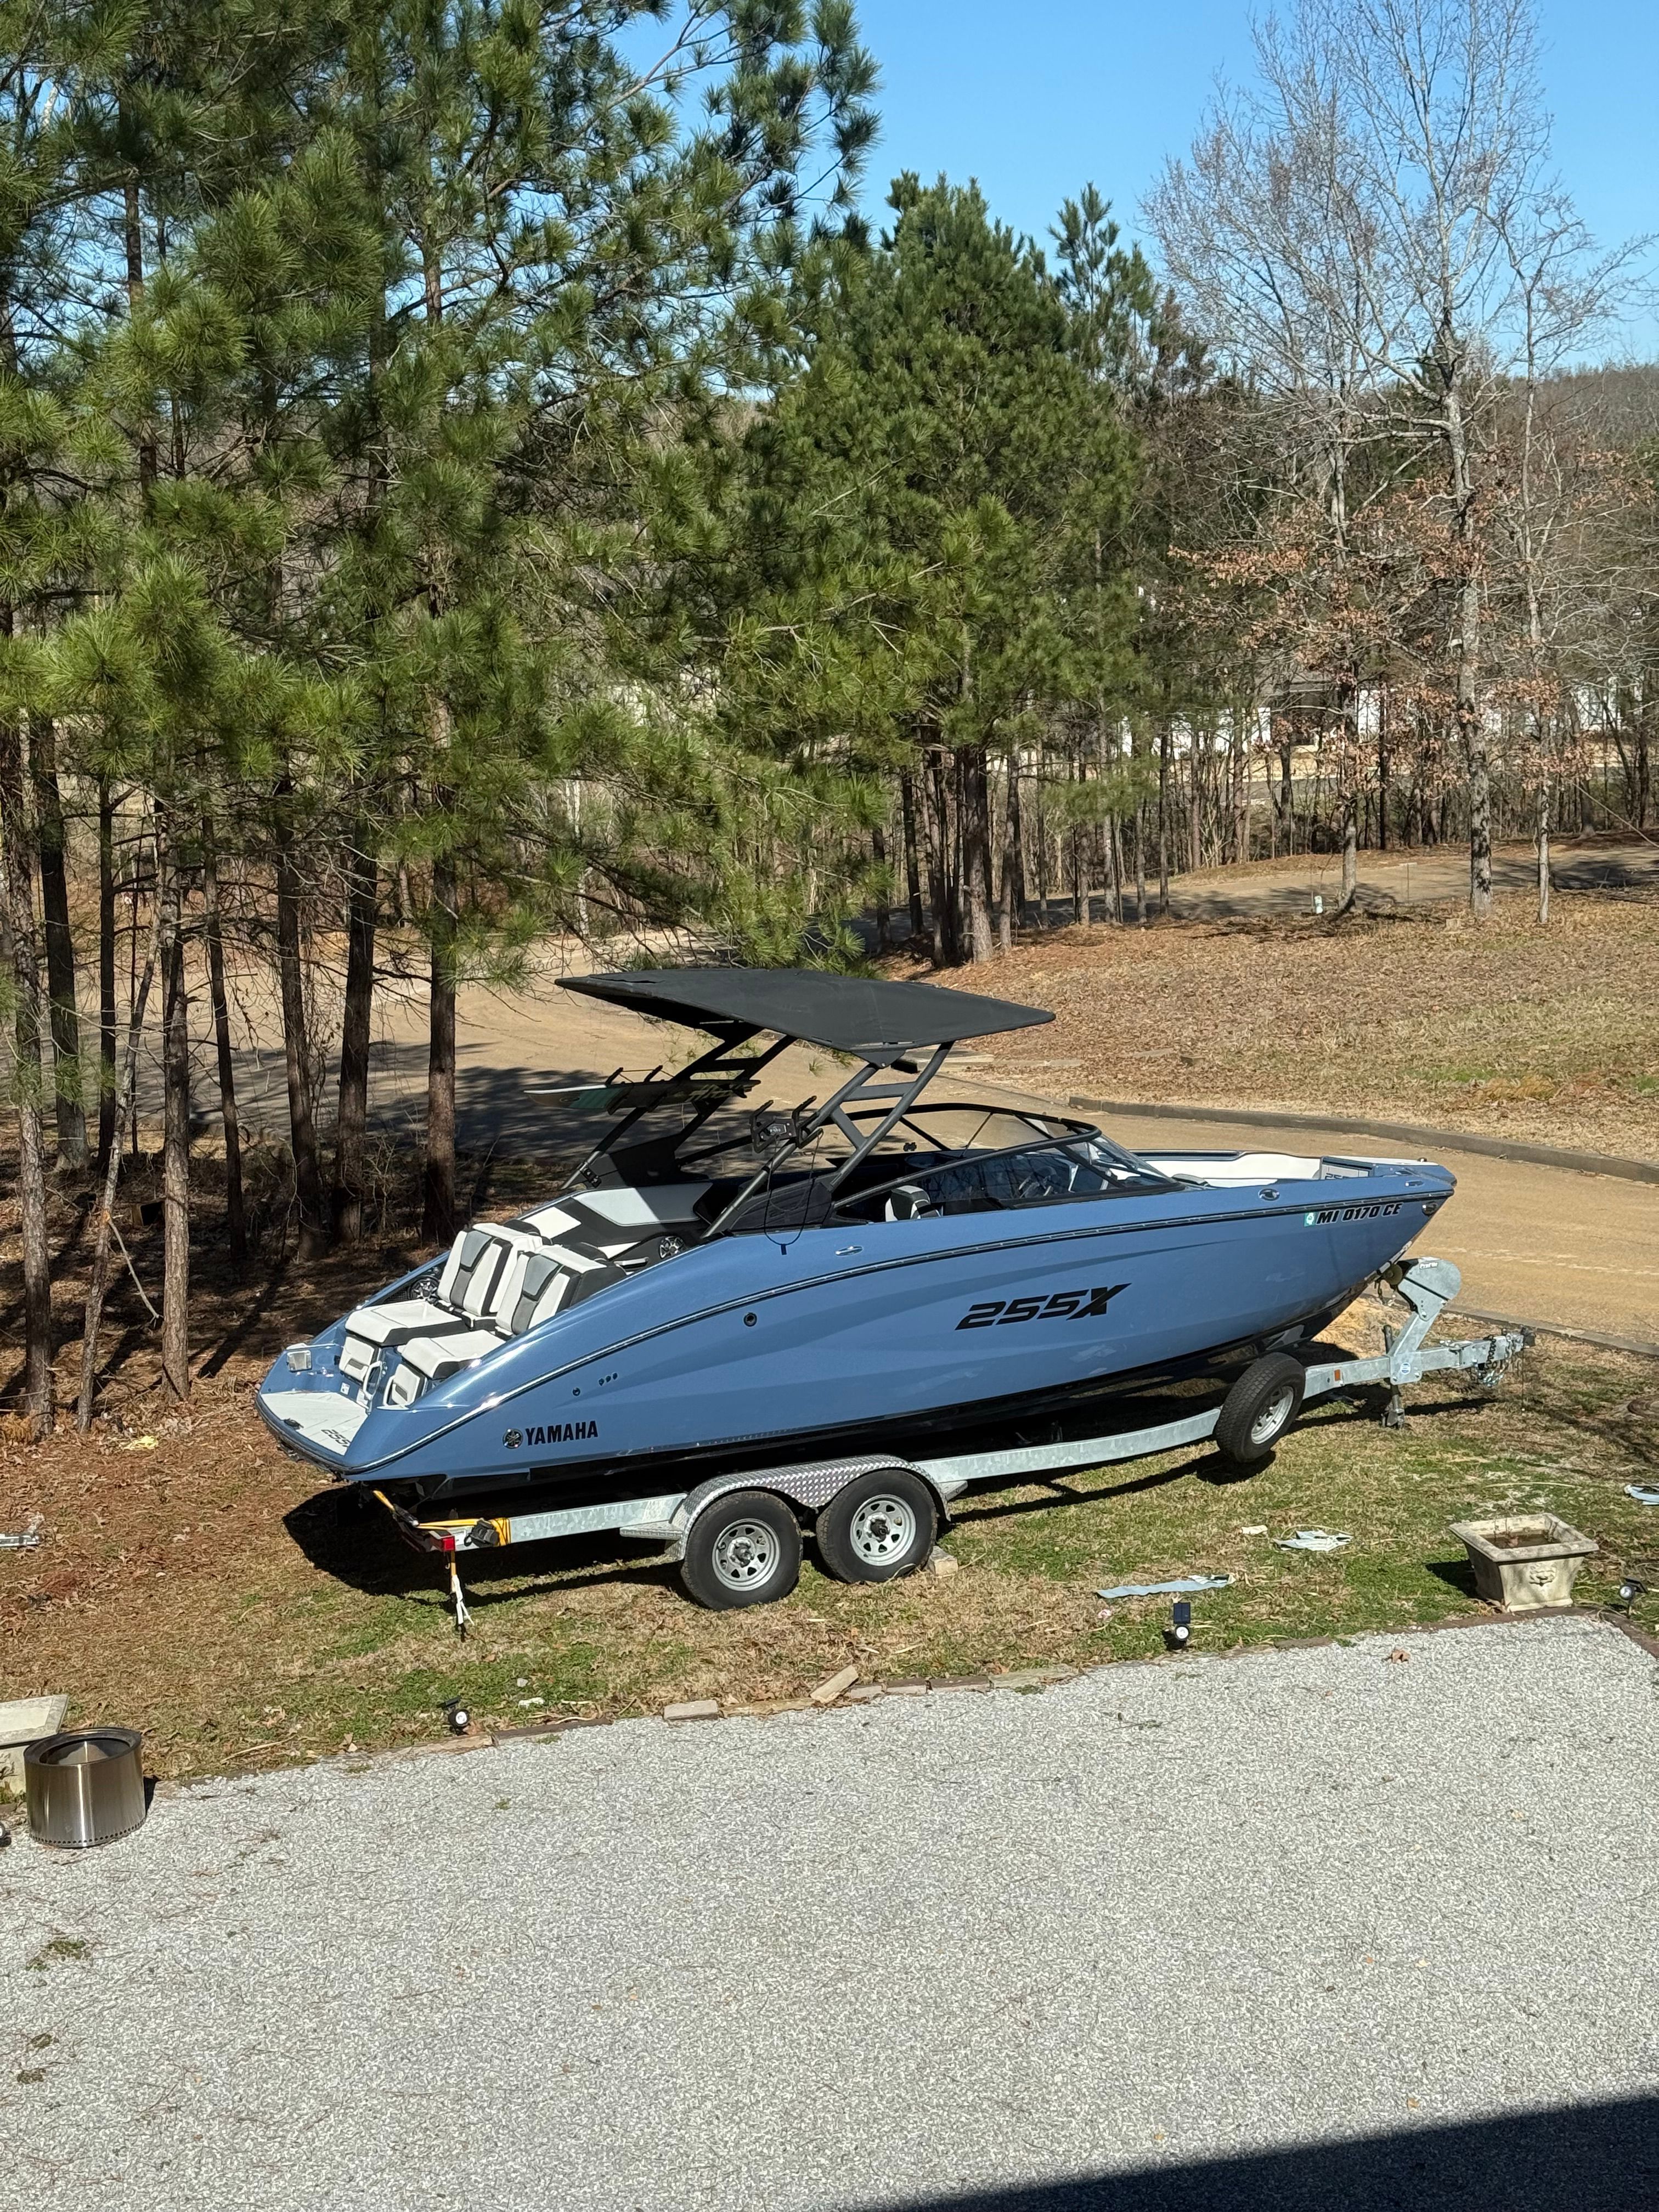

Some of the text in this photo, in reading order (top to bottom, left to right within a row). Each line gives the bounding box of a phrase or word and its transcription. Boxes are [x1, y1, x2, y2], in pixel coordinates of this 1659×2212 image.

[1317, 1203, 1403, 1225] MI 0170 CE
[955, 1283, 1132, 1330] 255X
[321, 1429, 352, 1447] 255
[525, 1420, 598, 1446] YAMAHA
